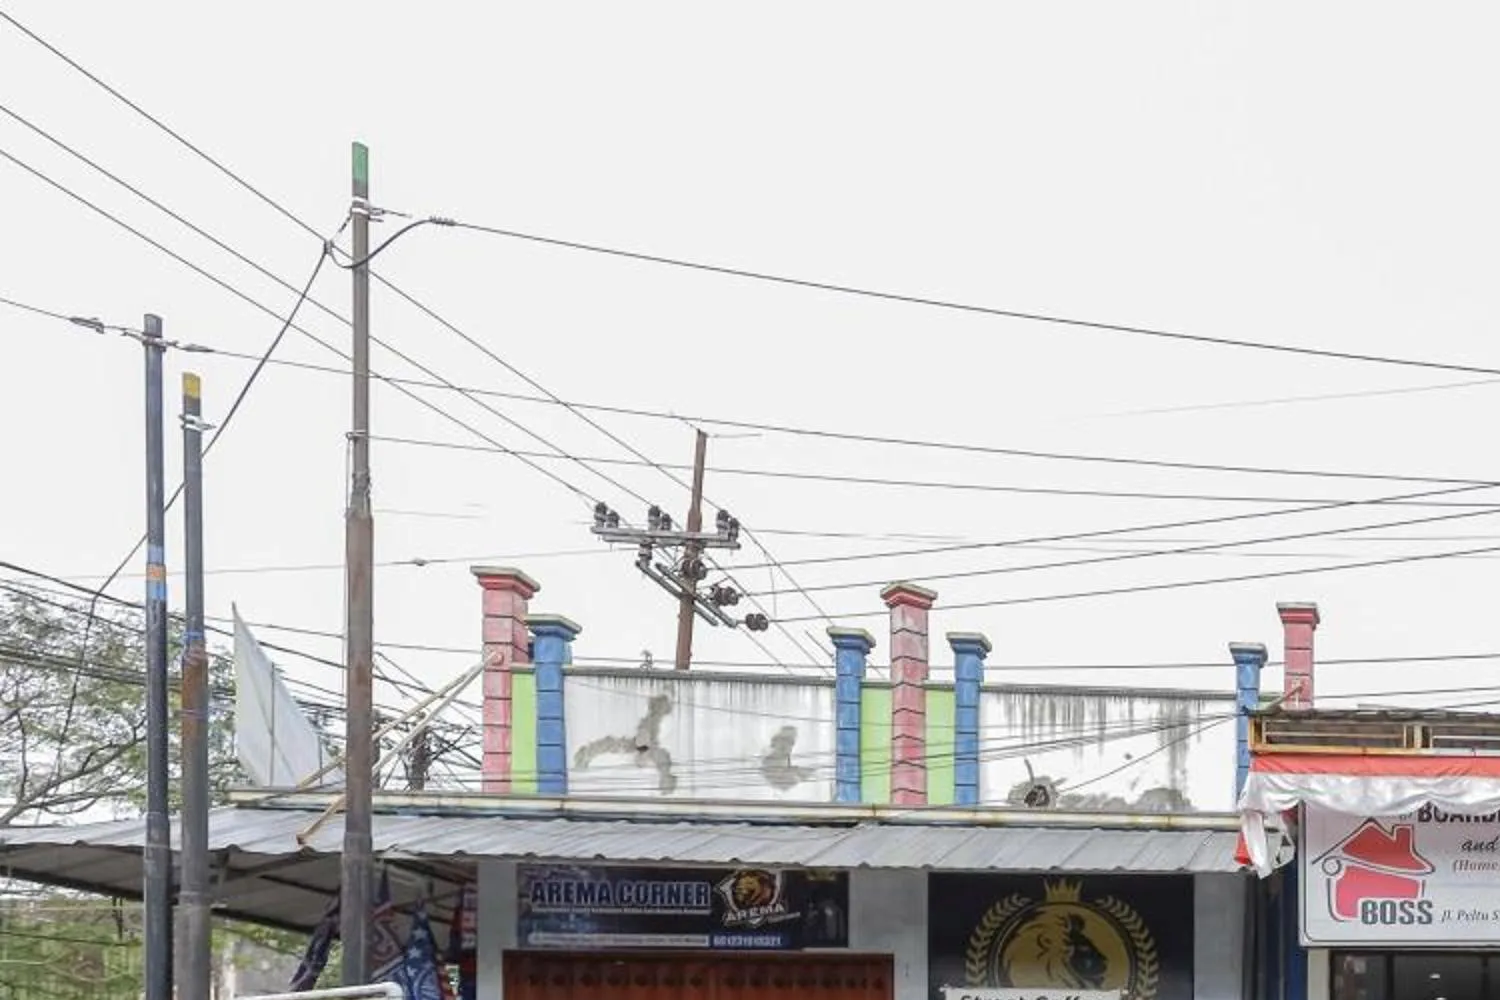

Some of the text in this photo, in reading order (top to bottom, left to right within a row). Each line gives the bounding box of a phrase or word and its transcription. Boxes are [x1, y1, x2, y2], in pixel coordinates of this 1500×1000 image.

[1461, 835, 1500, 852] and
[531, 879, 711, 907] AREMA CORNER
[1360, 900, 1433, 925] BOSS
